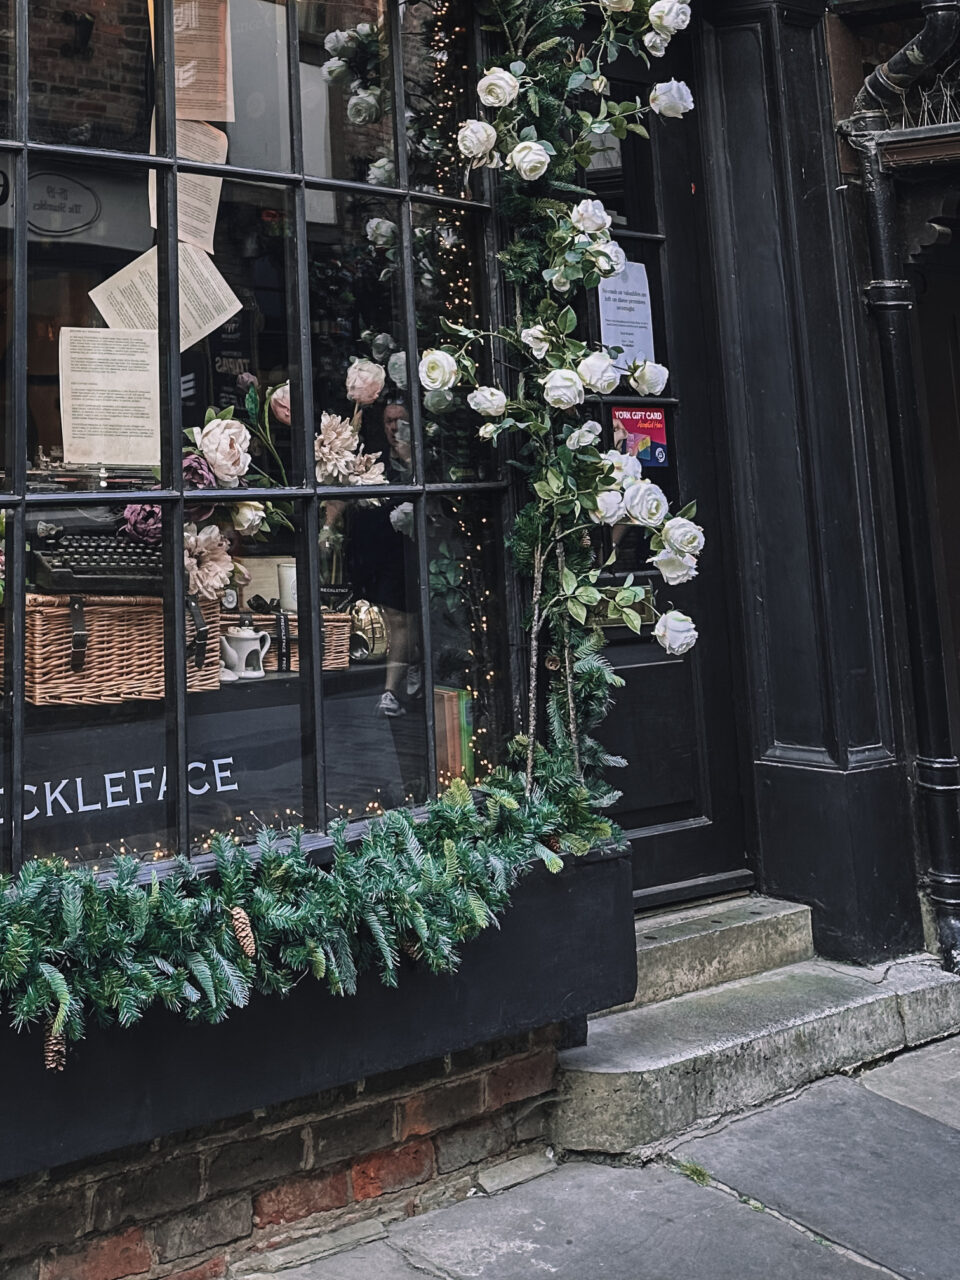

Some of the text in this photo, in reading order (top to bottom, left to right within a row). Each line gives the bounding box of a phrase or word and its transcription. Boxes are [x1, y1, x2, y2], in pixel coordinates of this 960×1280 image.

[614, 411, 662, 420] YORK GIFT CARD
